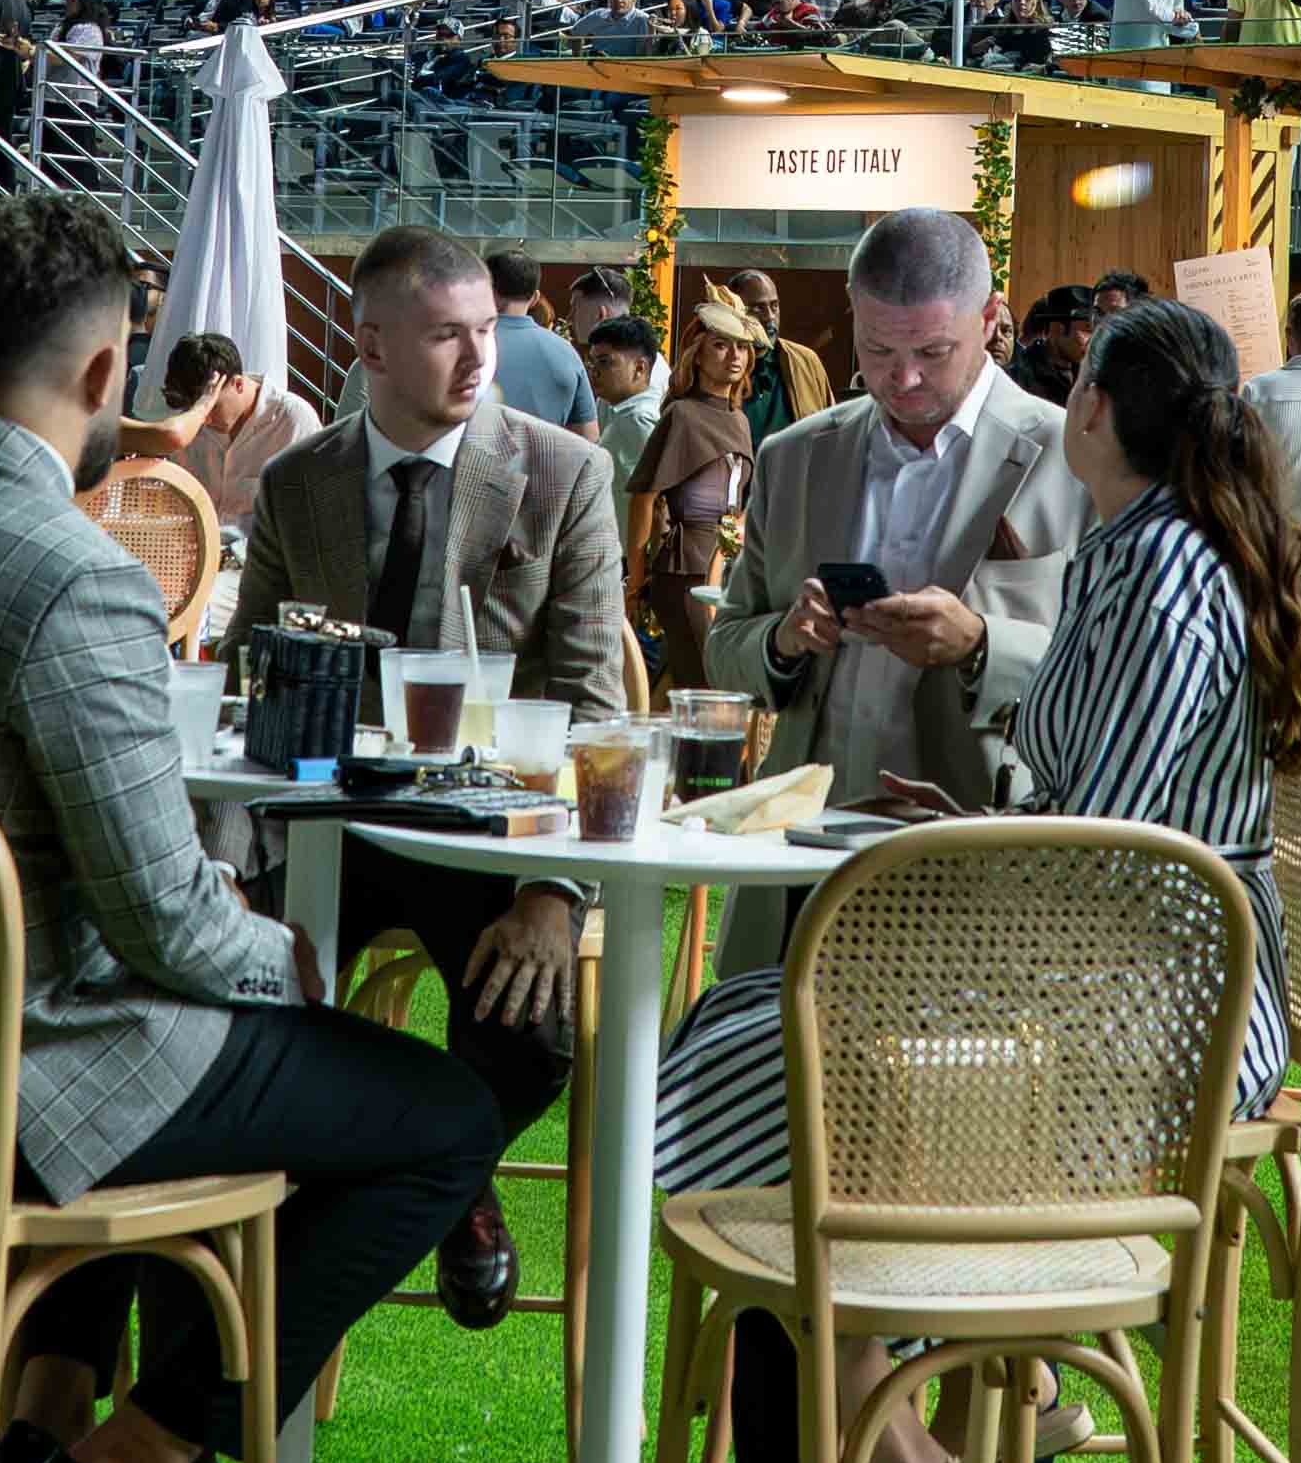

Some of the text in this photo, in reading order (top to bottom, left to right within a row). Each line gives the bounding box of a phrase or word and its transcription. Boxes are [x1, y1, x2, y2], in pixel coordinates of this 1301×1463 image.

[767, 148, 902, 174] TASTE OF ITALY
